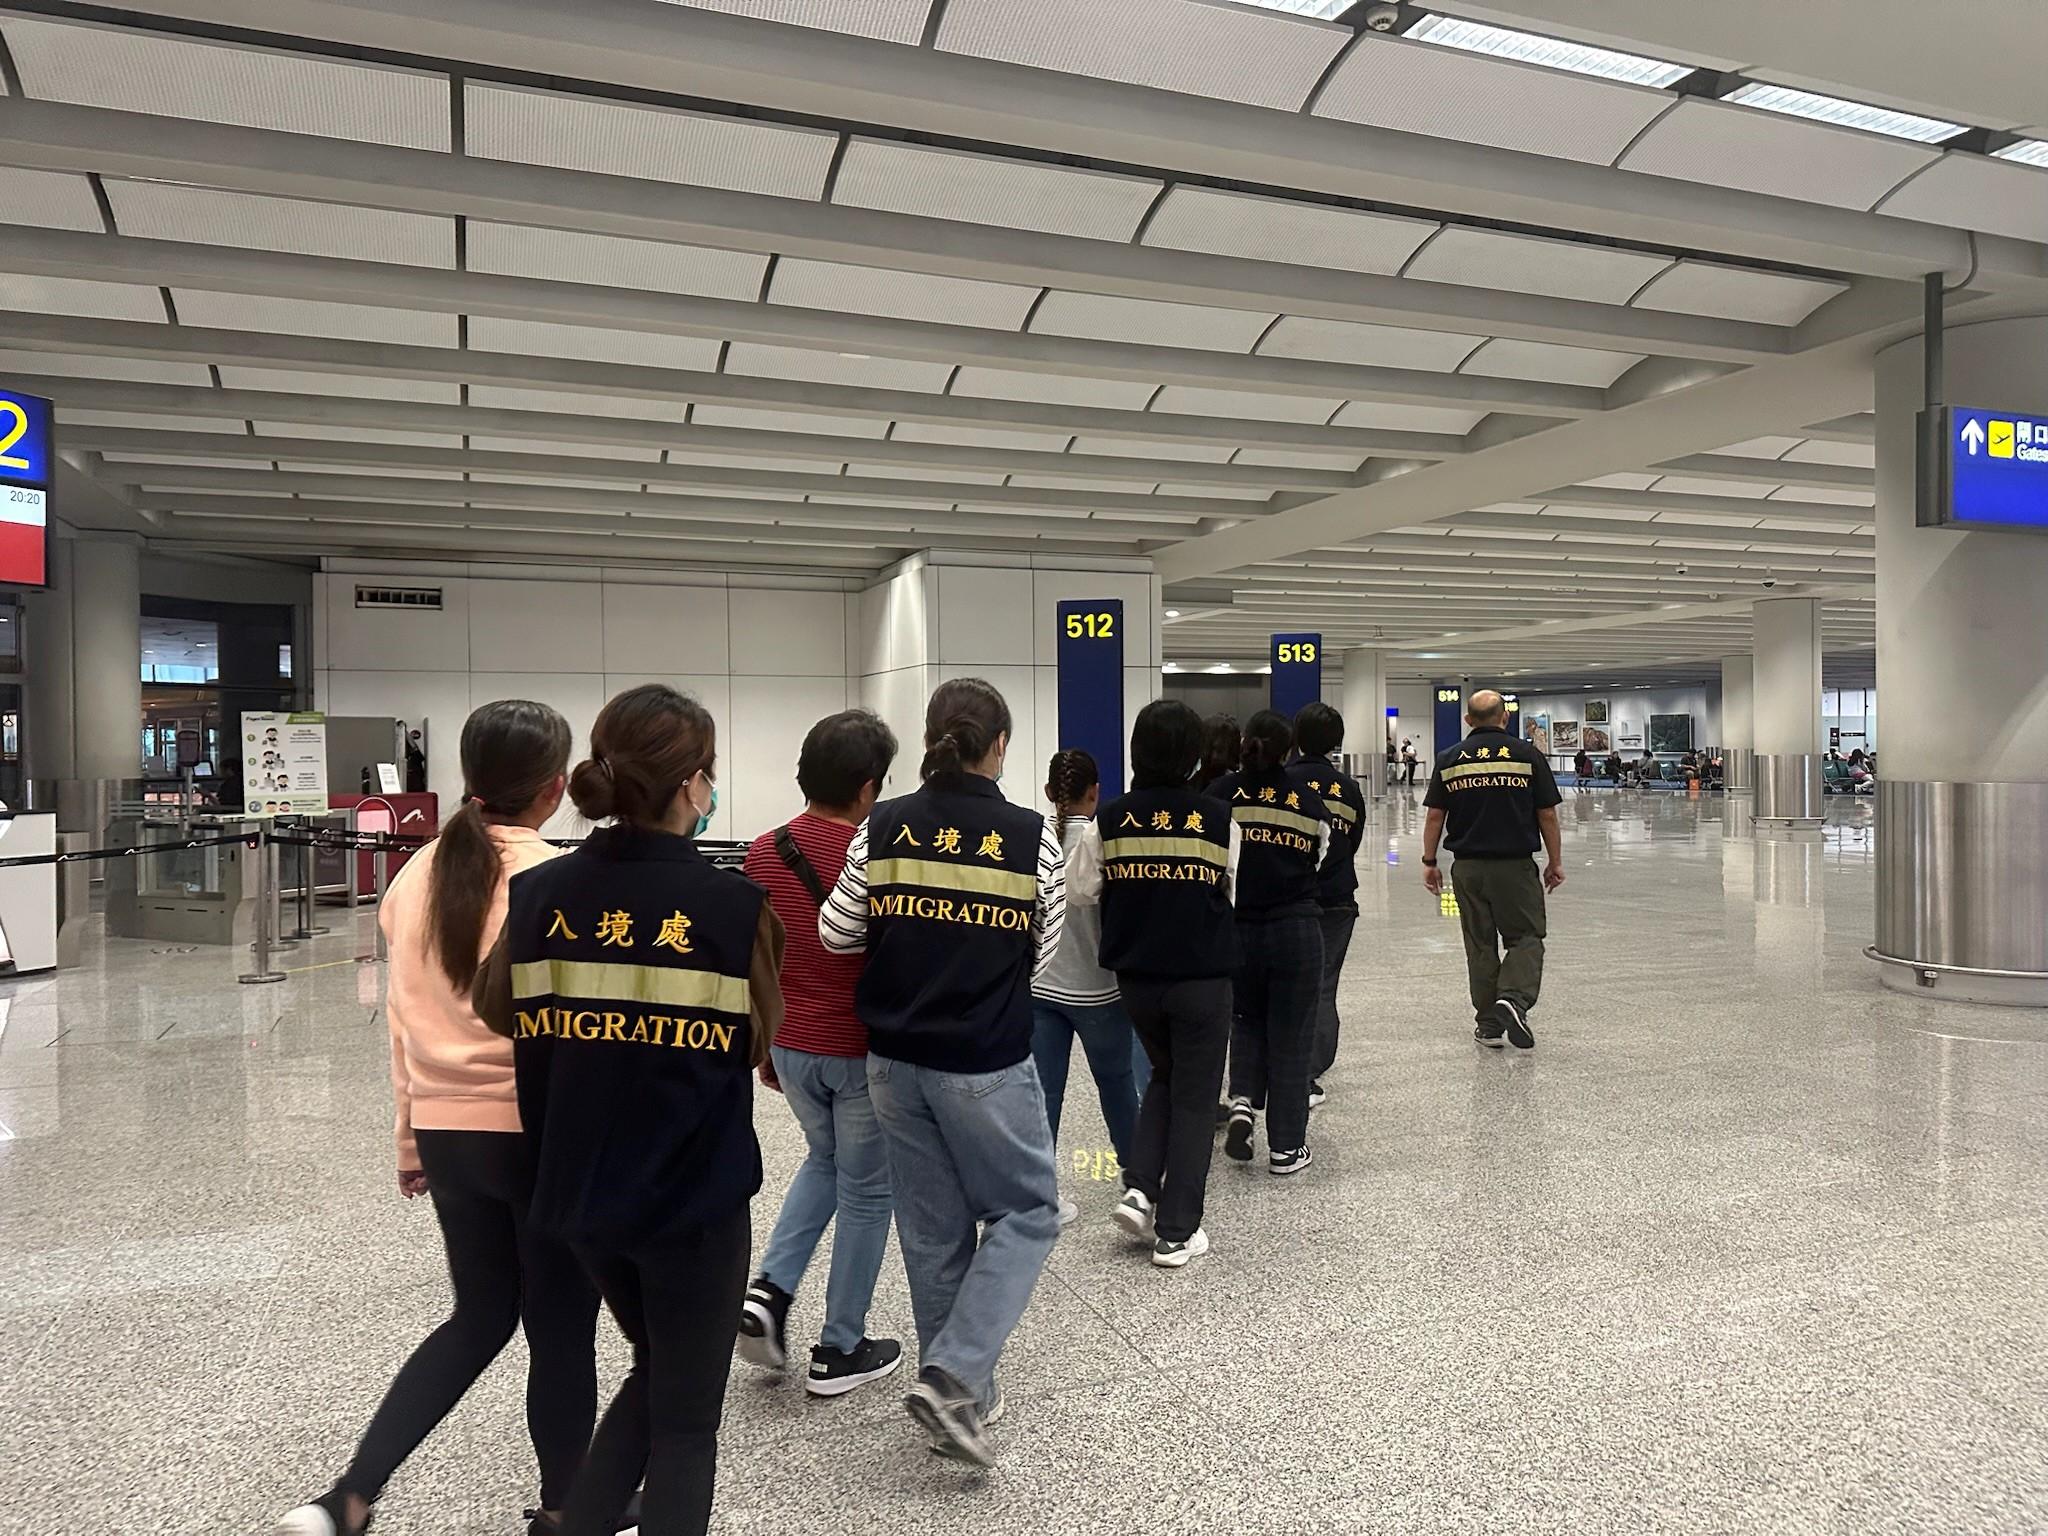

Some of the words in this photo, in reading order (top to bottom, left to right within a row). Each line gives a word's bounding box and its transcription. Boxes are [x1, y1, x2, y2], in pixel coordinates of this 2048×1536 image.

[10, 490, 40, 505] 20:20
[1067, 613, 1113, 638] 512
[1279, 643, 1316, 663] 513
[1438, 690, 1459, 702] 514
[1458, 745, 1511, 760] 入境處
[1232, 786, 1301, 809] 入境處
[1120, 810, 1205, 833] 入境處
[892, 824, 1005, 862] 入境處
[546, 909, 695, 954] 入境處
